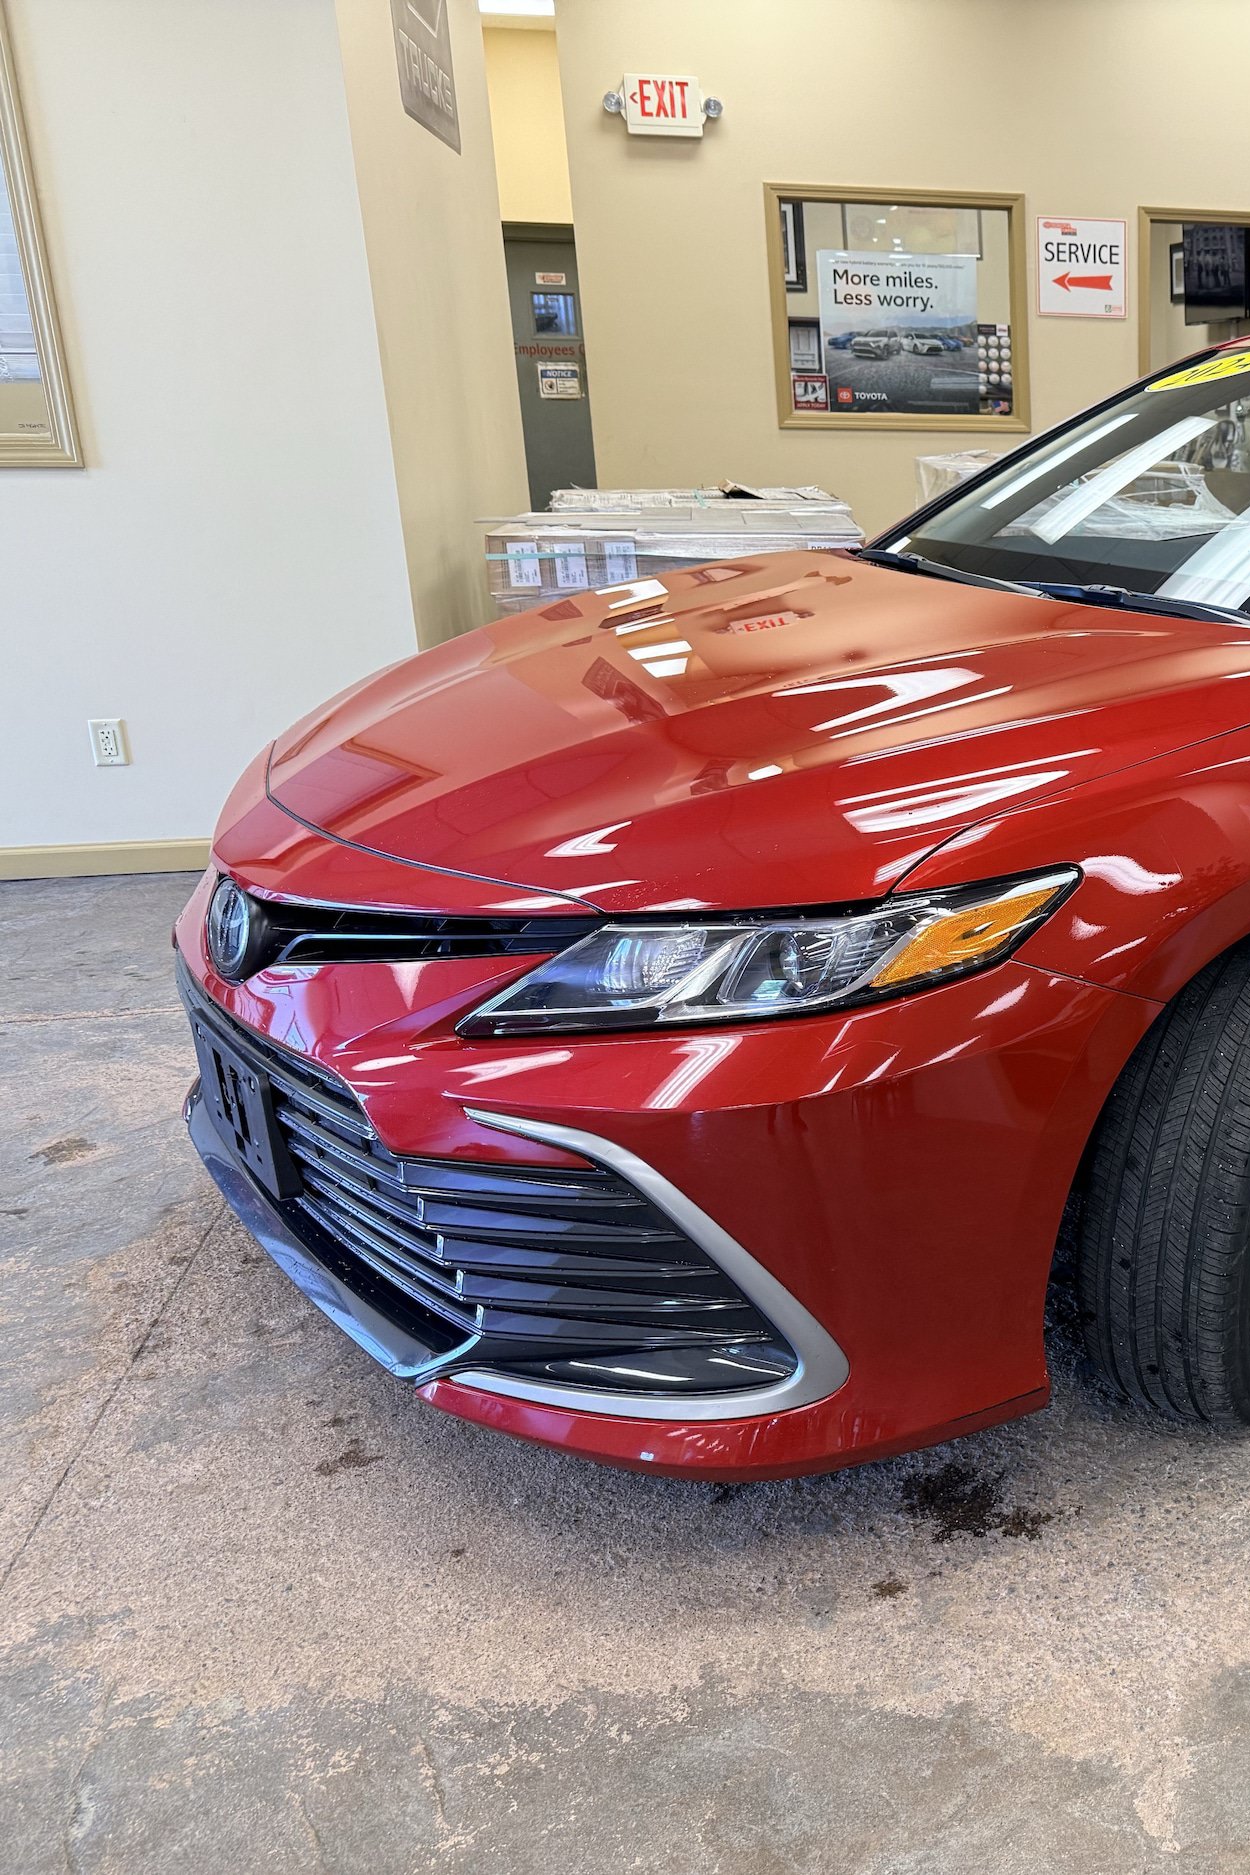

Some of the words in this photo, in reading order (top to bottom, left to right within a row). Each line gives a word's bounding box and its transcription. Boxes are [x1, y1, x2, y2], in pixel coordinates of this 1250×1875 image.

[638, 79, 689, 119] EXIT
[1044, 241, 1120, 265] SERVICE
[832, 268, 881, 287] More
[886, 271, 939, 290] miles.
[833, 288, 872, 306] Less
[877, 294, 934, 312] worry.
[546, 369, 572, 378] NOTICE
[854, 391, 888, 401] TOYOTA
